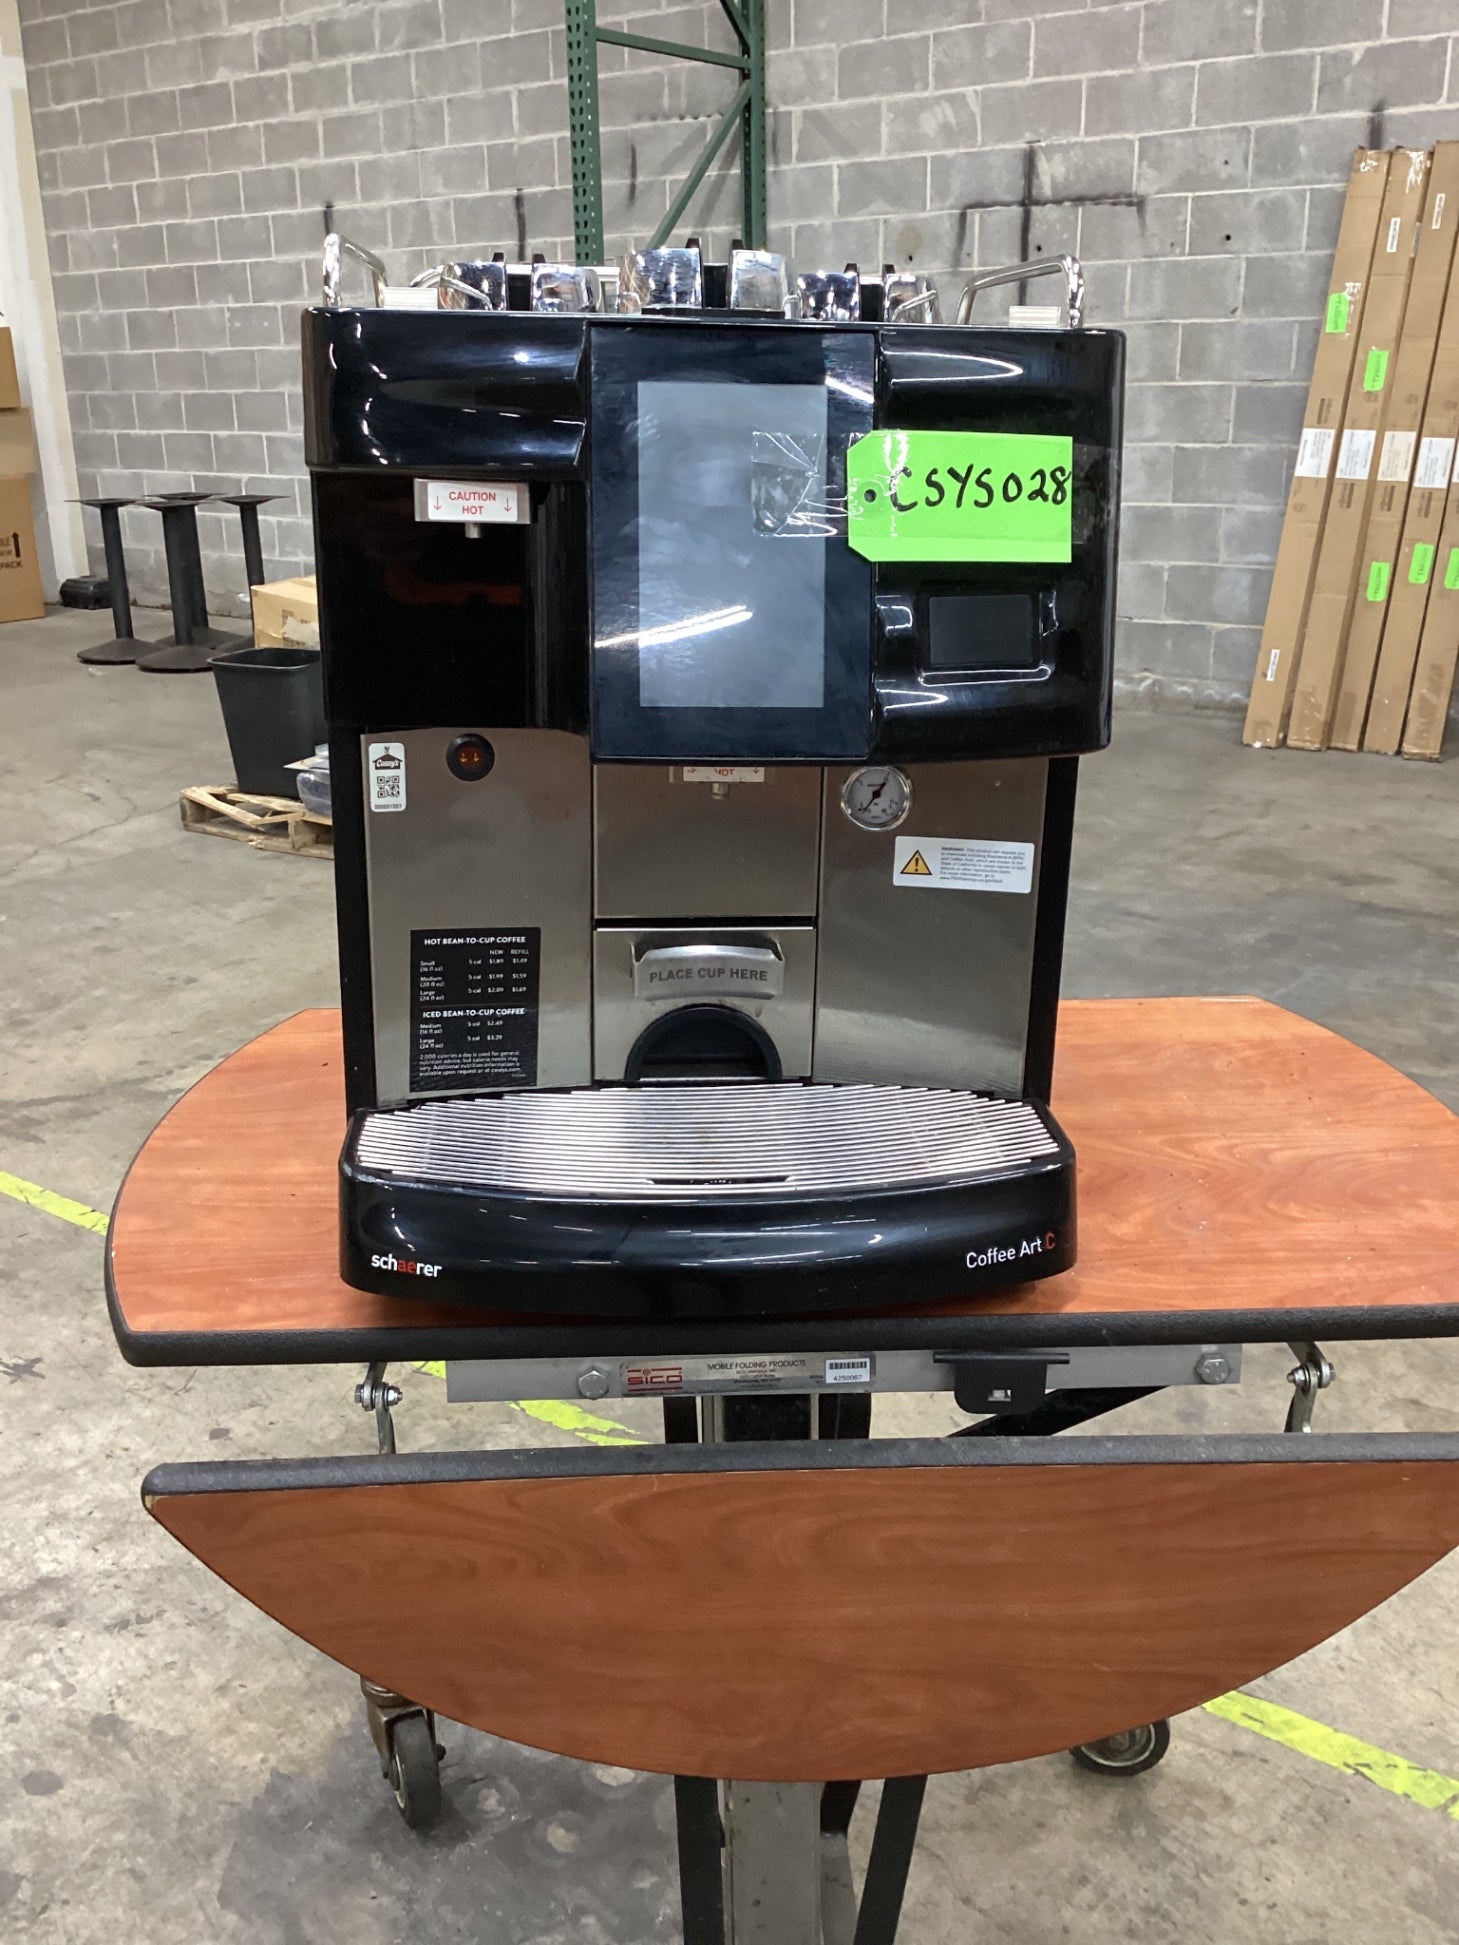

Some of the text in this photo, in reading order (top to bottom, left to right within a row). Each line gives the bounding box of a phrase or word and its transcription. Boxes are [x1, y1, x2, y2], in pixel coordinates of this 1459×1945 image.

[449, 491, 496, 502] CAUTION
[462, 505, 484, 515] HOT
[443, 936, 495, 944] BEAN-TO-CUP
[650, 968, 768, 983] PLACE CUP HERE
[443, 1008, 495, 1017] BEAN-TO-CUP
[496, 1007, 525, 1015] COFFEE
[966, 1231, 1056, 1268] Coffee Art C
[371, 1253, 443, 1277] schaerer
[707, 1359, 806, 1370] MOBILE FOLDING PRODUCTS
